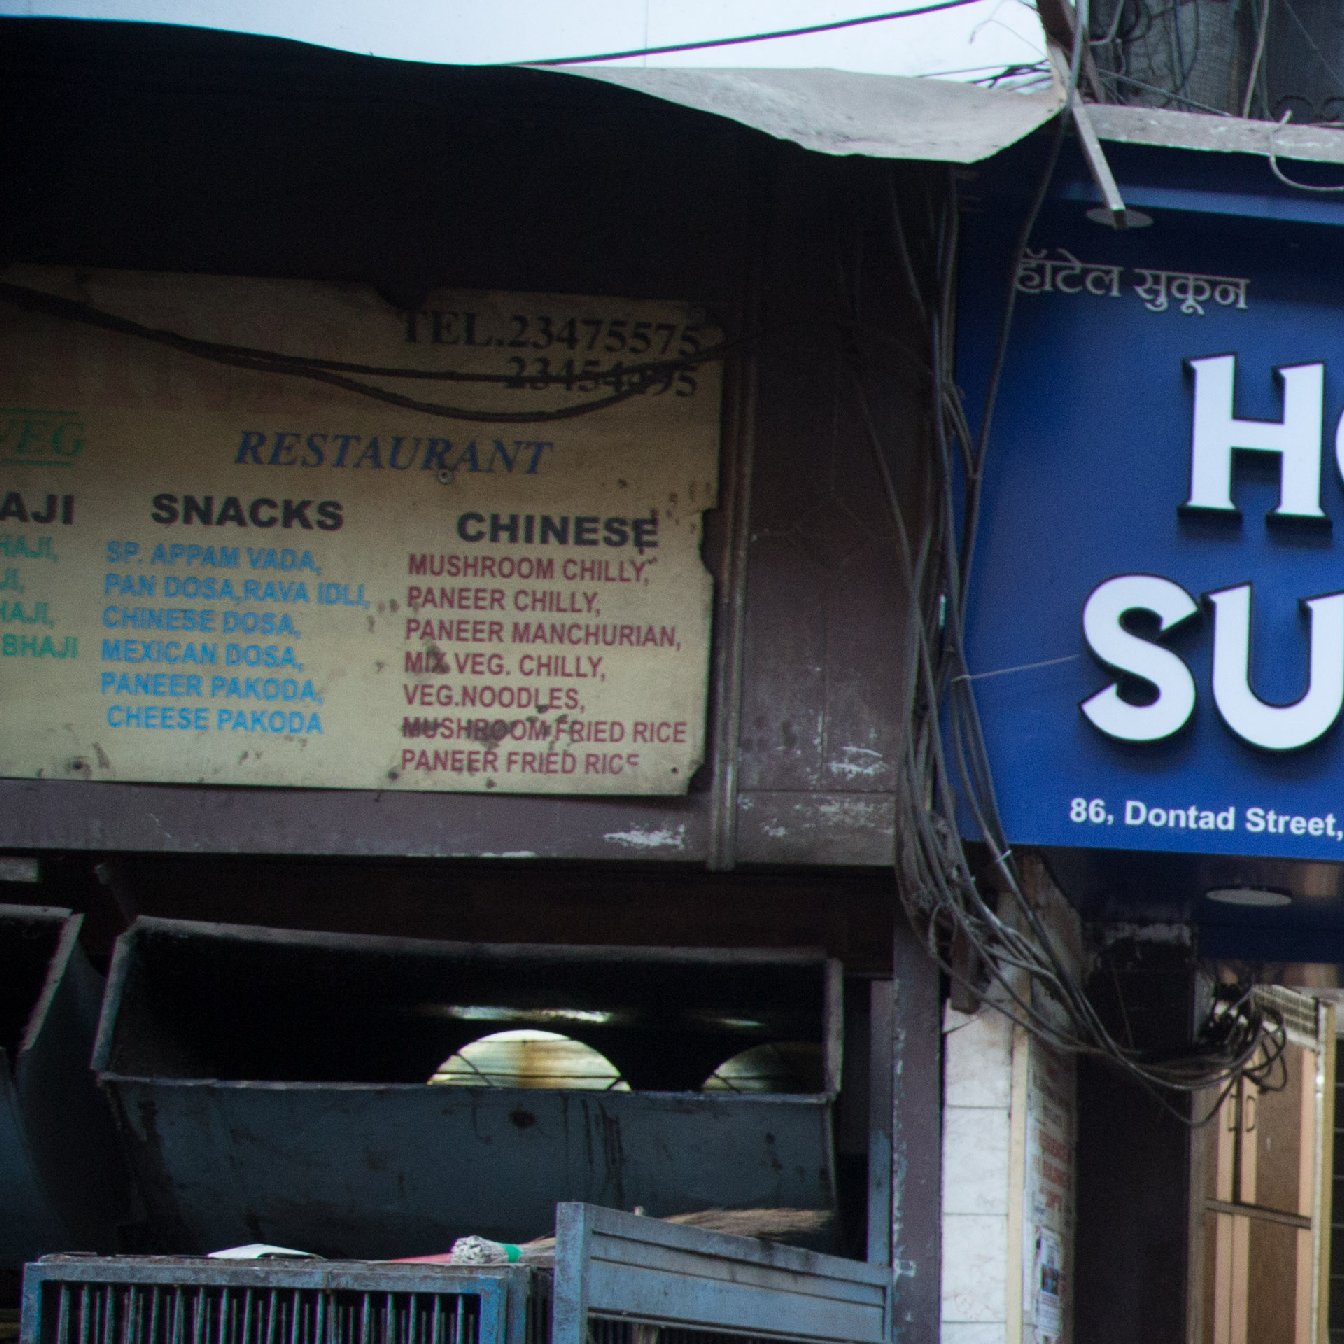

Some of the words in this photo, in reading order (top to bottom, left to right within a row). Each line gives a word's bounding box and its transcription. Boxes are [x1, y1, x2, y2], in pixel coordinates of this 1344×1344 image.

[1133, 268, 1250, 315] सुकून
[235, 430, 554, 475] RESTAURANT
[151, 494, 345, 530] SNACKS
[457, 512, 659, 547] CHINESE
[106, 541, 143, 564] SP.
[151, 543, 240, 568] APPAM
[249, 547, 321, 575] VADA,
[407, 554, 555, 580] MUSHROOM
[562, 558, 650, 585] CHILLY,
[104, 573, 155, 597] PAN
[406, 586, 506, 610] PANEER
[514, 590, 600, 616] CHILLY,
[103, 605, 217, 633] CHINESE
[222, 611, 300, 639] DOSA,
[405, 619, 505, 643] PANEER
[512, 622, 681, 650] MANCHURIAN,
[101, 639, 218, 666] MEXICAN
[225, 644, 304, 673] DOSA,
[404, 651, 449, 674] MIX
[455, 653, 511, 676] VEG.
[519, 655, 605, 681] CHILLY,
[101, 672, 204, 698] PANEER
[211, 676, 324, 705] PAKODA,
[107, 706, 209, 731] CHEESE
[217, 709, 324, 734] PAKODA
[402, 717, 547, 742] MUSHROOM
[555, 721, 625, 743] FRIED
[633, 722, 687, 743] RICE
[401, 749, 498, 773] PANEER
[507, 751, 576, 774] FRIED
[1070, 797, 1114, 825] 86,
[1125, 800, 1235, 831] Dontad
[1245, 807, 1344, 841] Street,
